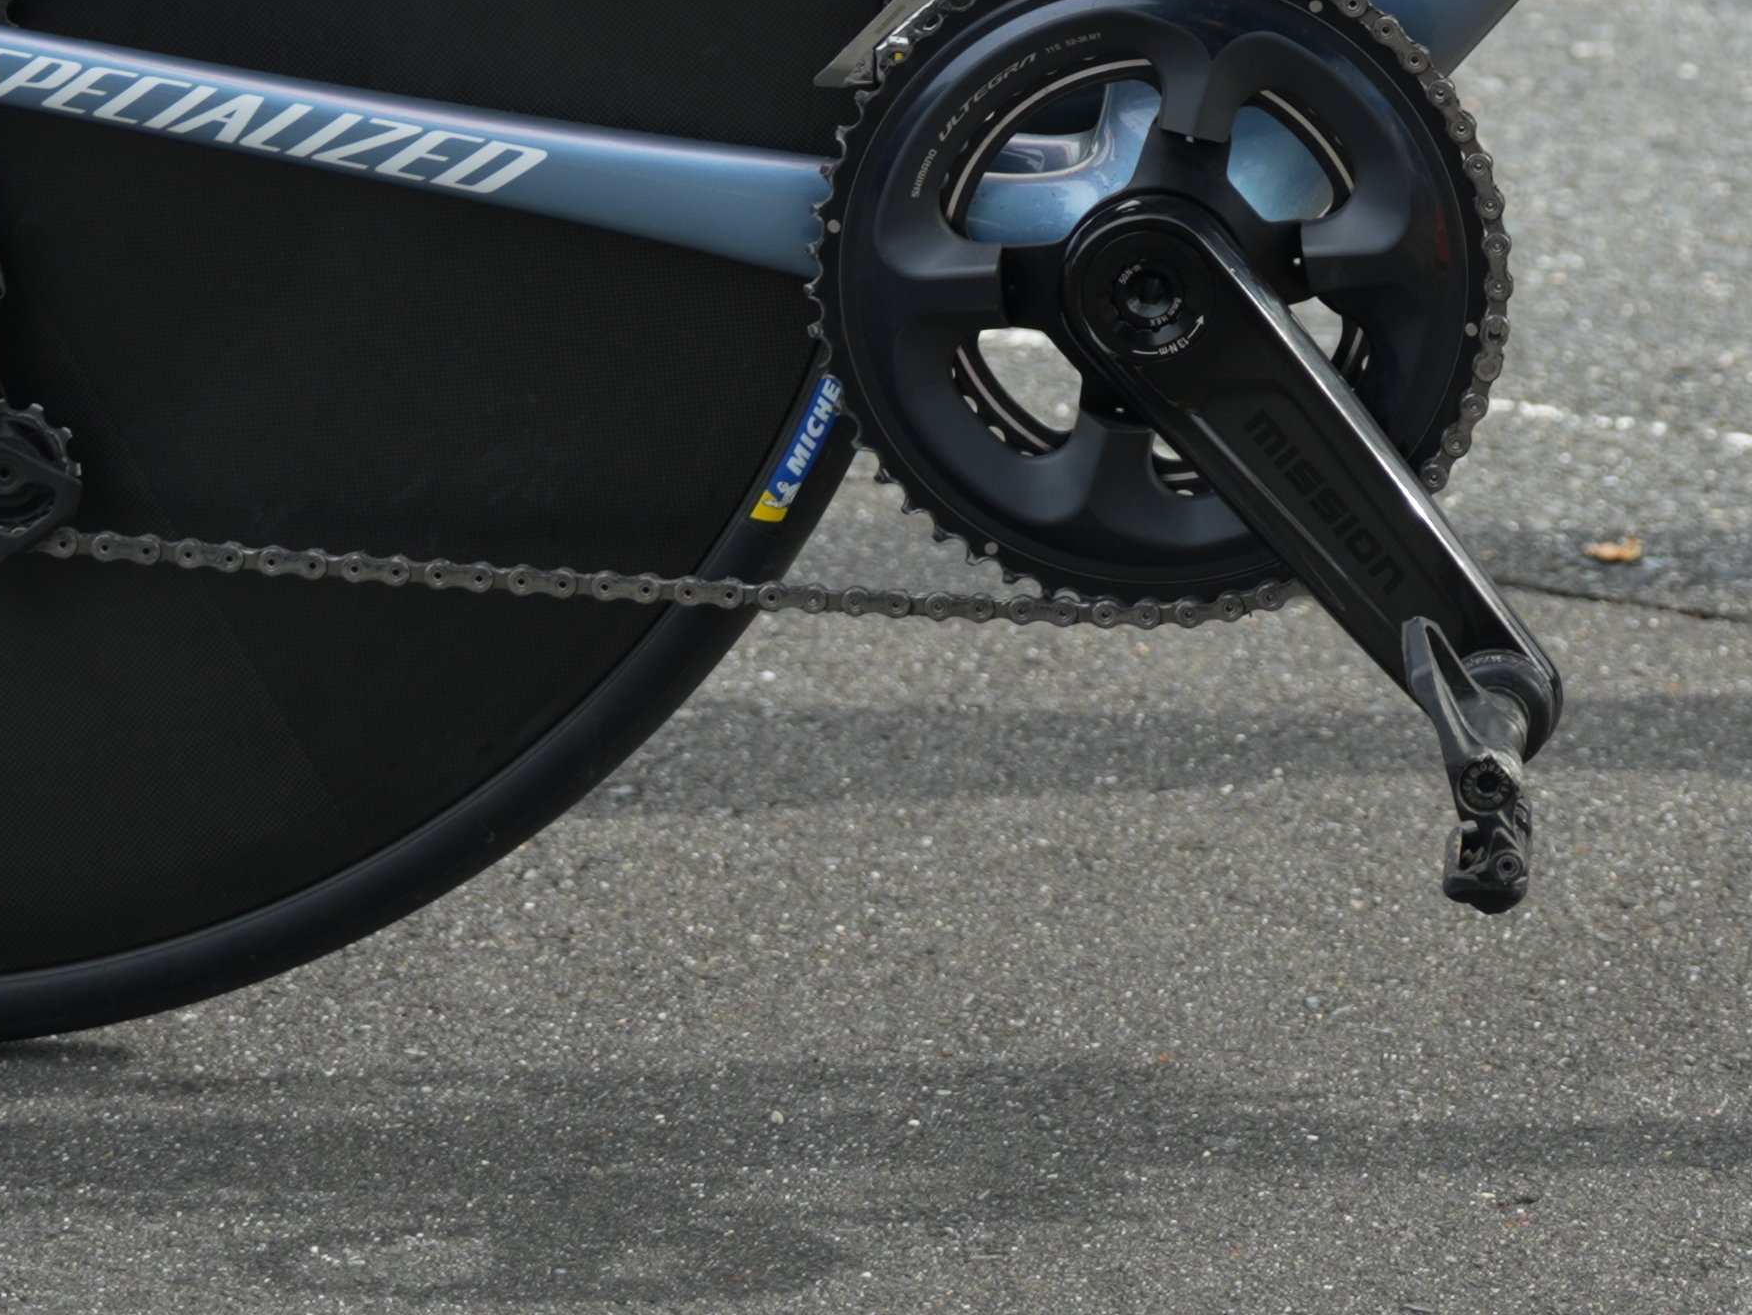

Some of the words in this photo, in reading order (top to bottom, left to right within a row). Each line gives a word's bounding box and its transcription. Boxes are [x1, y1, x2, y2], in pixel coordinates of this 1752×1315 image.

[911, 148, 937, 198] SHIMANO
[938, 52, 1037, 142] ULTEGRA
[786, 377, 843, 477] MICHE
